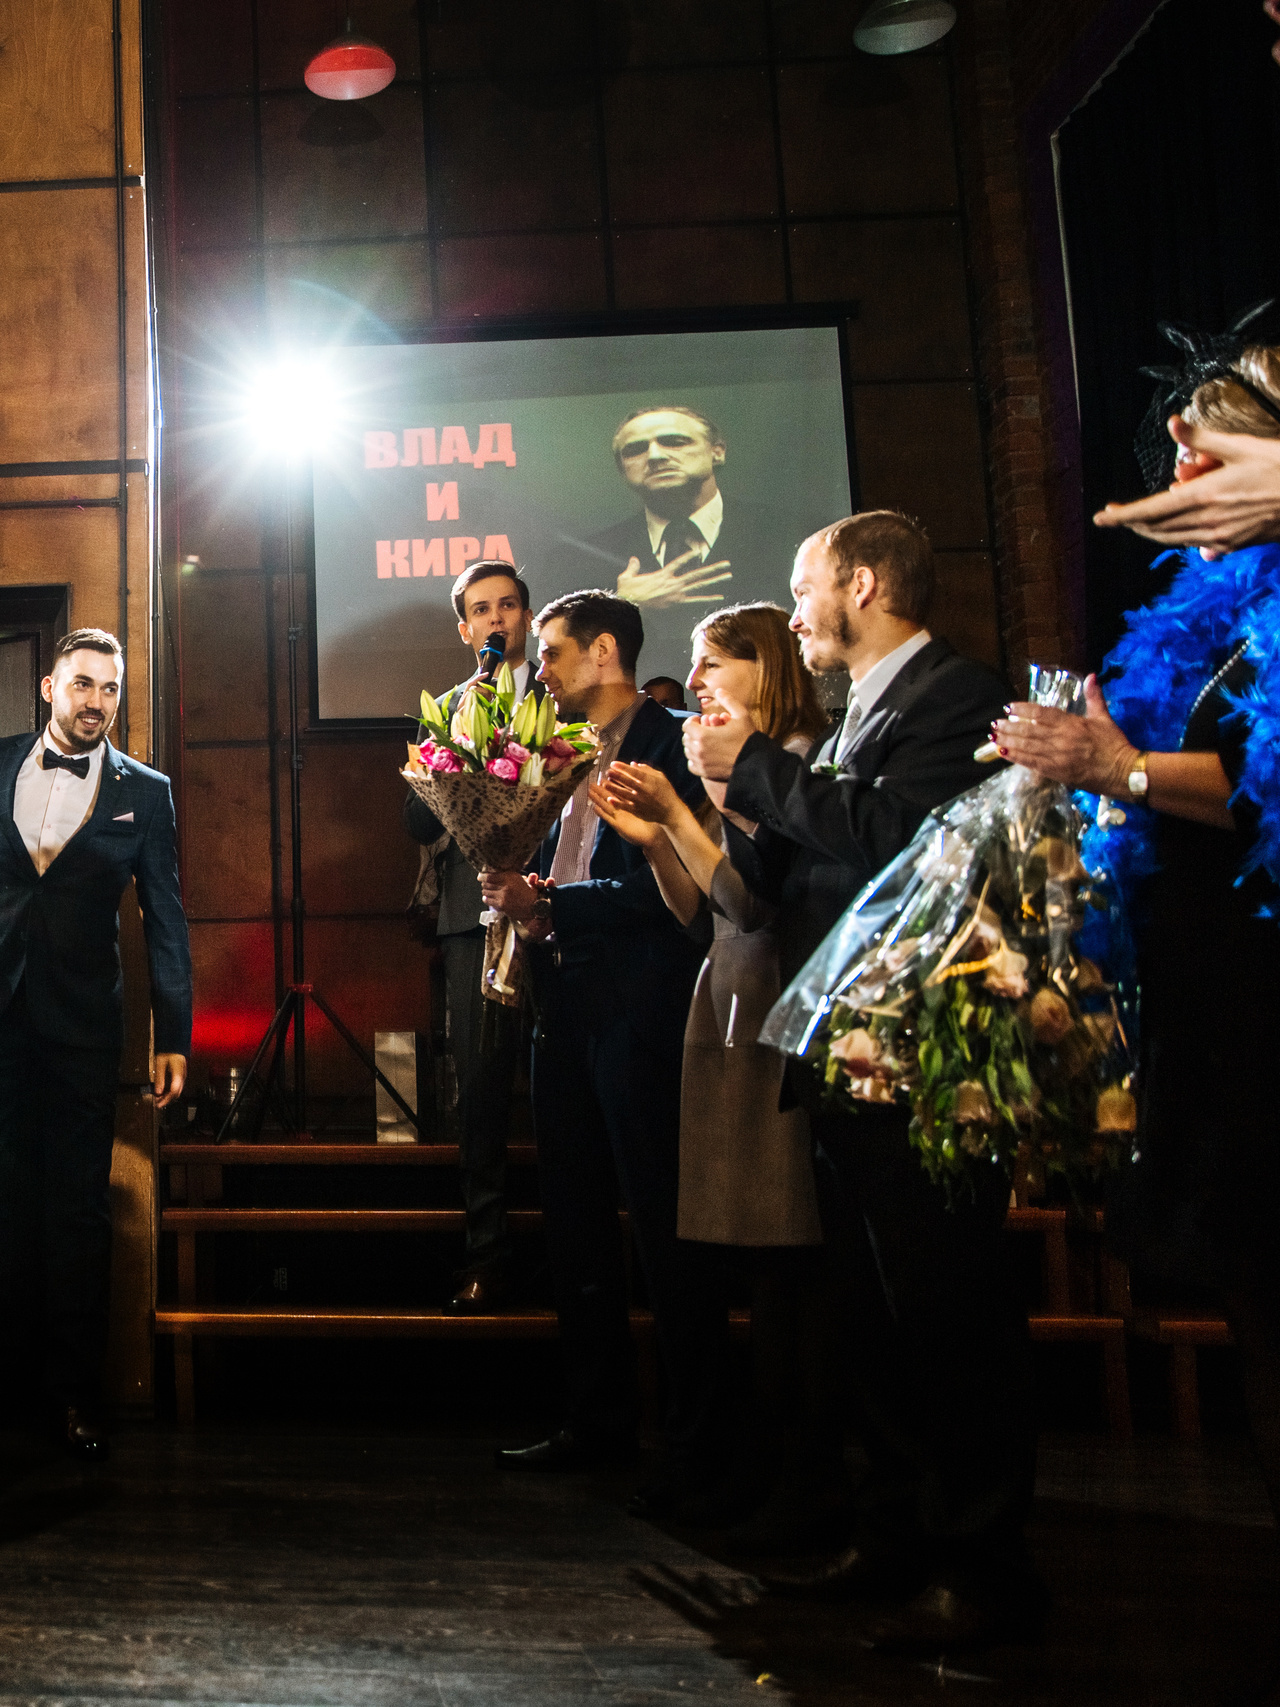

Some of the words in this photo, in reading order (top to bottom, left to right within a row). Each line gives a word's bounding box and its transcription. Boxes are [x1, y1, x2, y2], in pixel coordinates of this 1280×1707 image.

[364, 423, 517, 469] ВЛАД
[426, 481, 460, 521] И
[376, 534, 517, 579] КИРА
